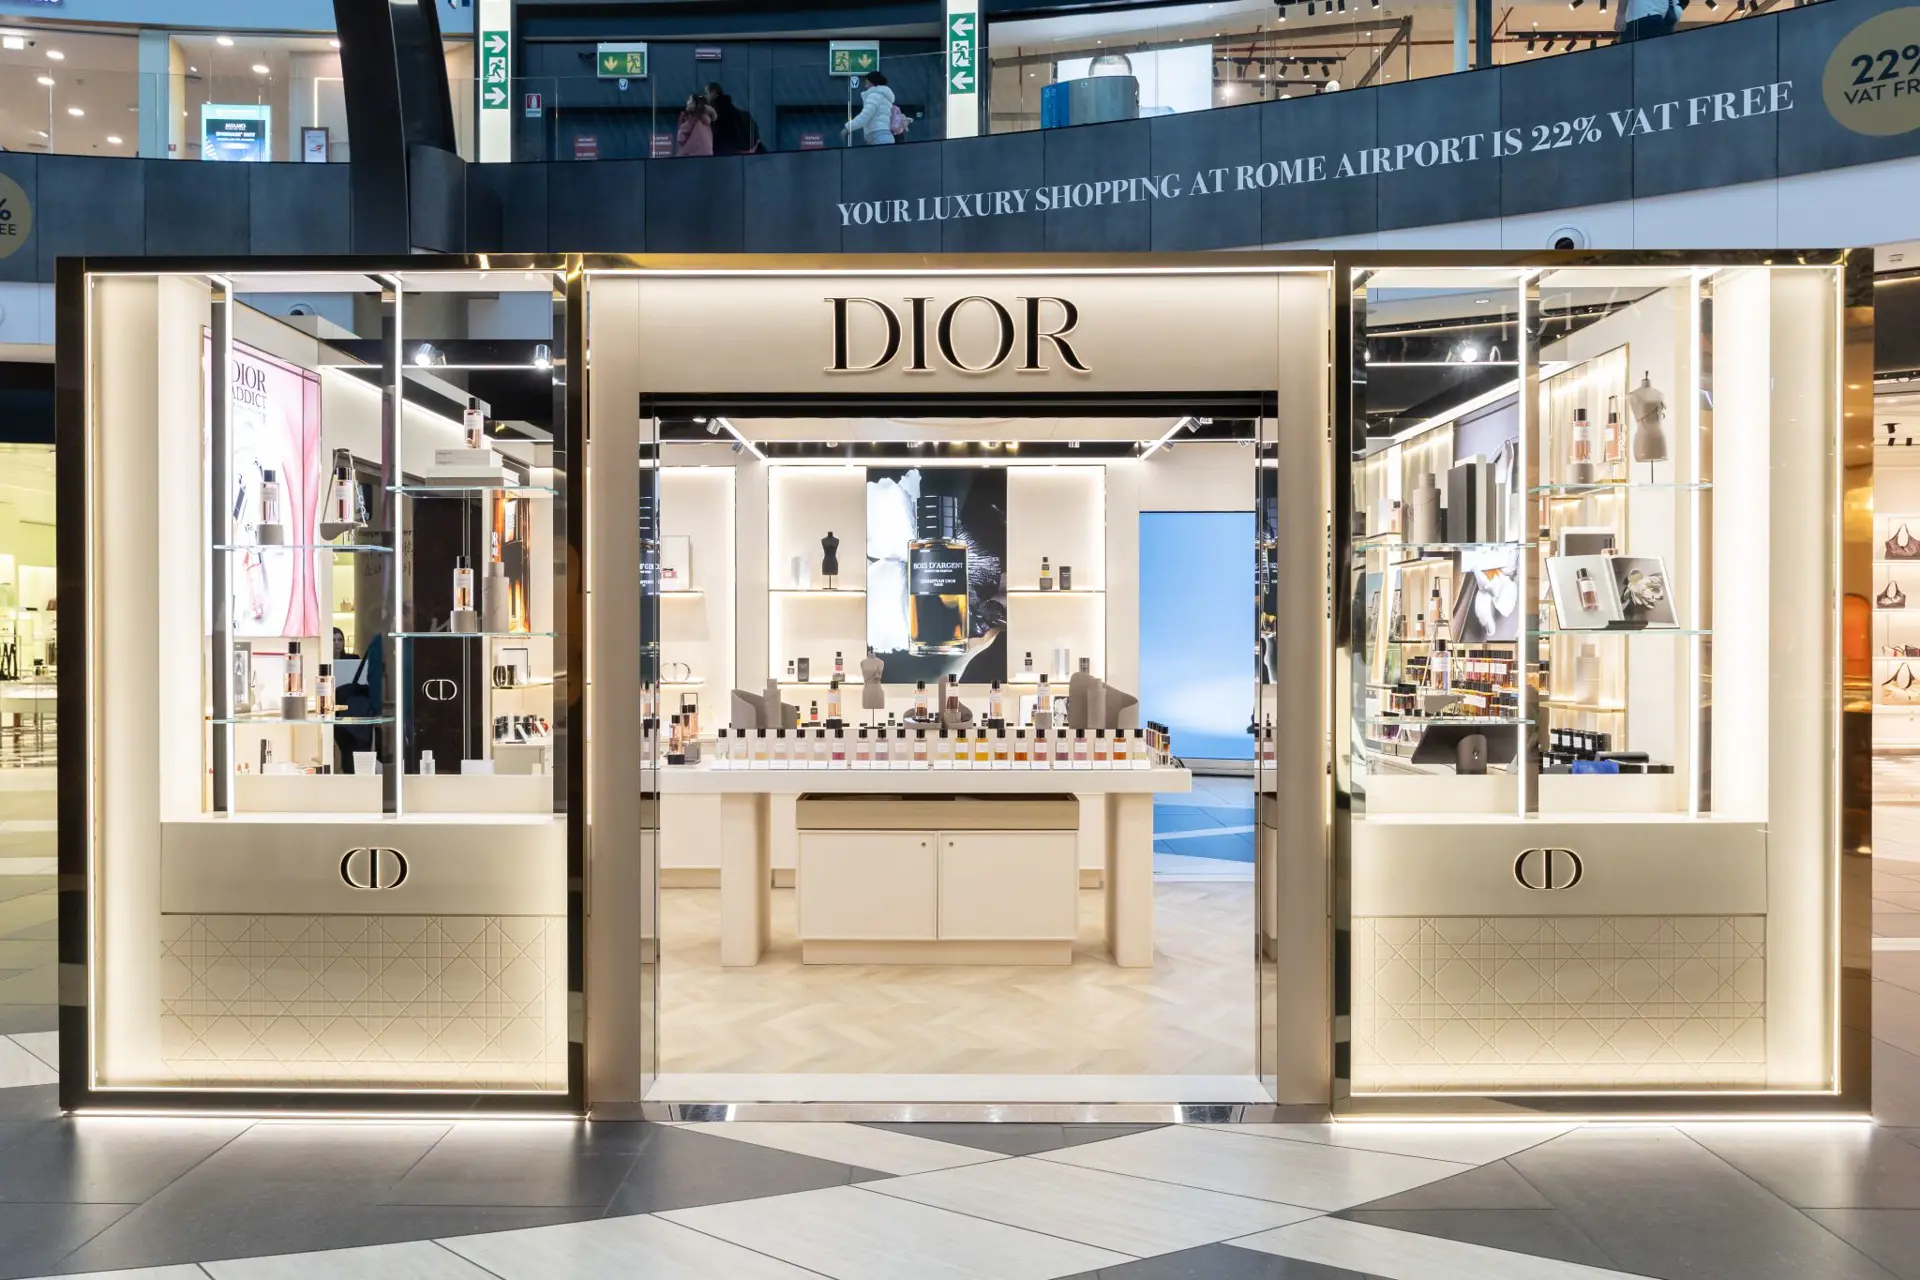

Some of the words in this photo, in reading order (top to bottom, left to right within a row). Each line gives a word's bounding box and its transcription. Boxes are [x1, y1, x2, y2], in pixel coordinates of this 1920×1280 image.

[1844, 84, 1886, 105] VAT
[837, 199, 912, 228] YOUR
[917, 188, 1029, 221] LUXURY
[1035, 174, 1183, 212] SHOPPING
[1189, 168, 1229, 196] AT
[1235, 155, 1326, 191] ROME
[1336, 133, 1485, 179] AIRPORT
[1493, 127, 1523, 159] IS
[1531, 115, 1602, 152] 22%
[1607, 100, 1679, 138] VAT
[1686, 80, 1795, 127] FREE
[824, 296, 1091, 373] DIOR
[232, 360, 267, 394] DIOR
[913, 562, 928, 570] BOIS
[340, 846, 409, 891] CD
[1513, 846, 1584, 891] CD
